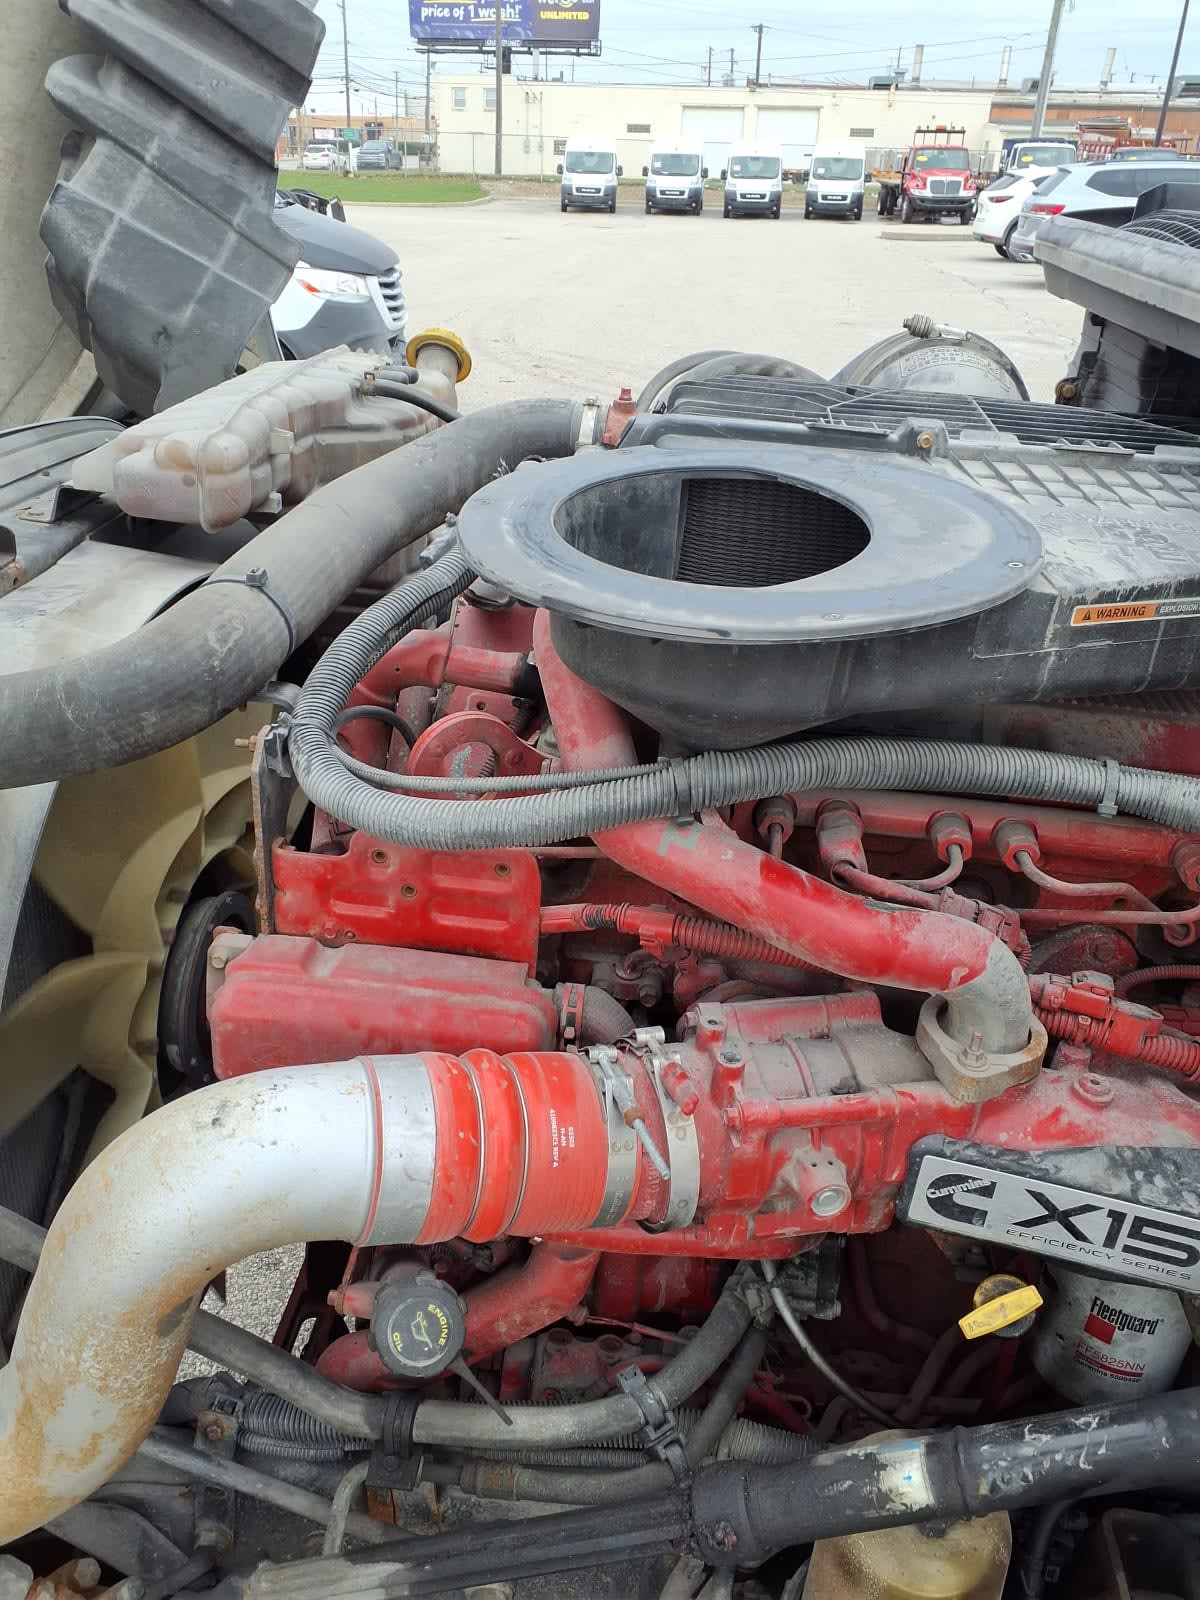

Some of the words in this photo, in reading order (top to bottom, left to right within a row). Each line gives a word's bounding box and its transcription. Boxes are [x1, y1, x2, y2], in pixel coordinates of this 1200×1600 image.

[421, 5, 450, 22] price
[453, 6, 465, 21] of
[469, 5, 475, 18] 1
[540, 11, 590, 21] UNLIMITED
[1096, 606, 1146, 619] WARNING
[1160, 603, 1197, 614] EXPLOSION
[926, 1178, 992, 1199] Cummins
[1011, 1188, 1200, 1268] X15
[1005, 1228, 1115, 1261] EFFICIENCY
[1121, 1257, 1192, 1281] SERIES
[427, 1304, 448, 1346] ENGINE
[1090, 1296, 1159, 1336] Fleetguard
[392, 1332, 404, 1352] OIL
